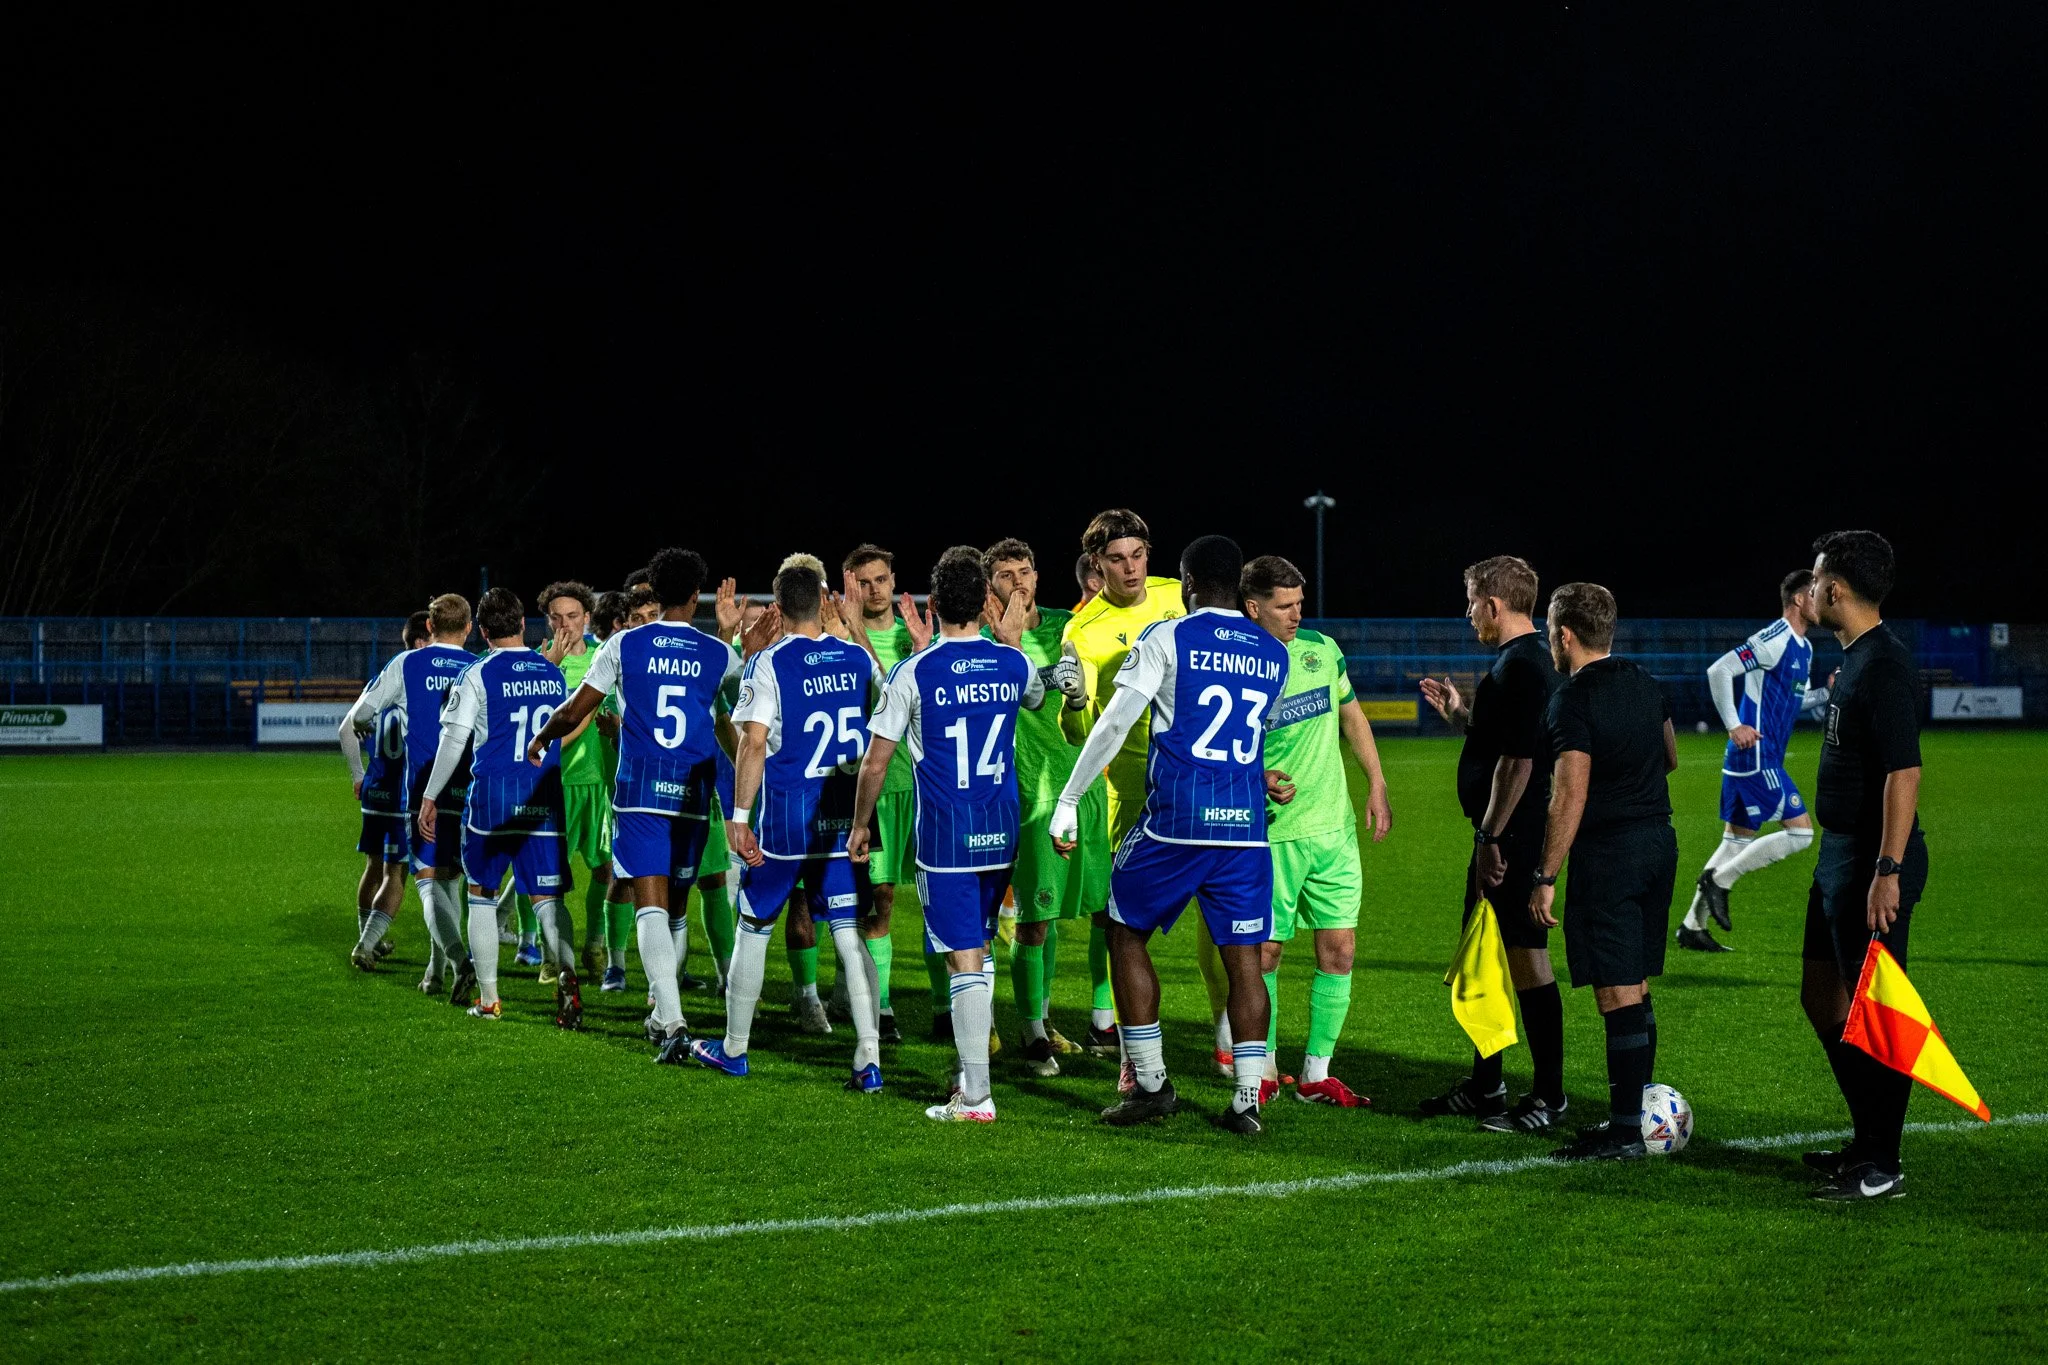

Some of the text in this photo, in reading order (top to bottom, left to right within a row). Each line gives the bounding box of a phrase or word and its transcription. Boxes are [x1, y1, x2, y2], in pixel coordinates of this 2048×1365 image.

[647, 657, 701, 677] AMADO
[1189, 650, 1280, 682] EZENNOLIM
[502, 680, 563, 698] RICHARDS
[803, 673, 857, 697] CURLEY
[935, 683, 1019, 706] C. WESTON
[1280, 694, 1313, 709] UNIVERSITY
[1283, 698, 1329, 721] OXFORD
[1, 711, 55, 725] Pinnacle
[653, 685, 687, 749] 5
[1191, 685, 1268, 765] 23
[803, 707, 865, 779] 25
[945, 713, 1007, 789] 14
[656, 782, 692, 797] HiSPEC
[1204, 807, 1251, 822] HiSPEC
[969, 833, 1006, 849] HiSPEC
